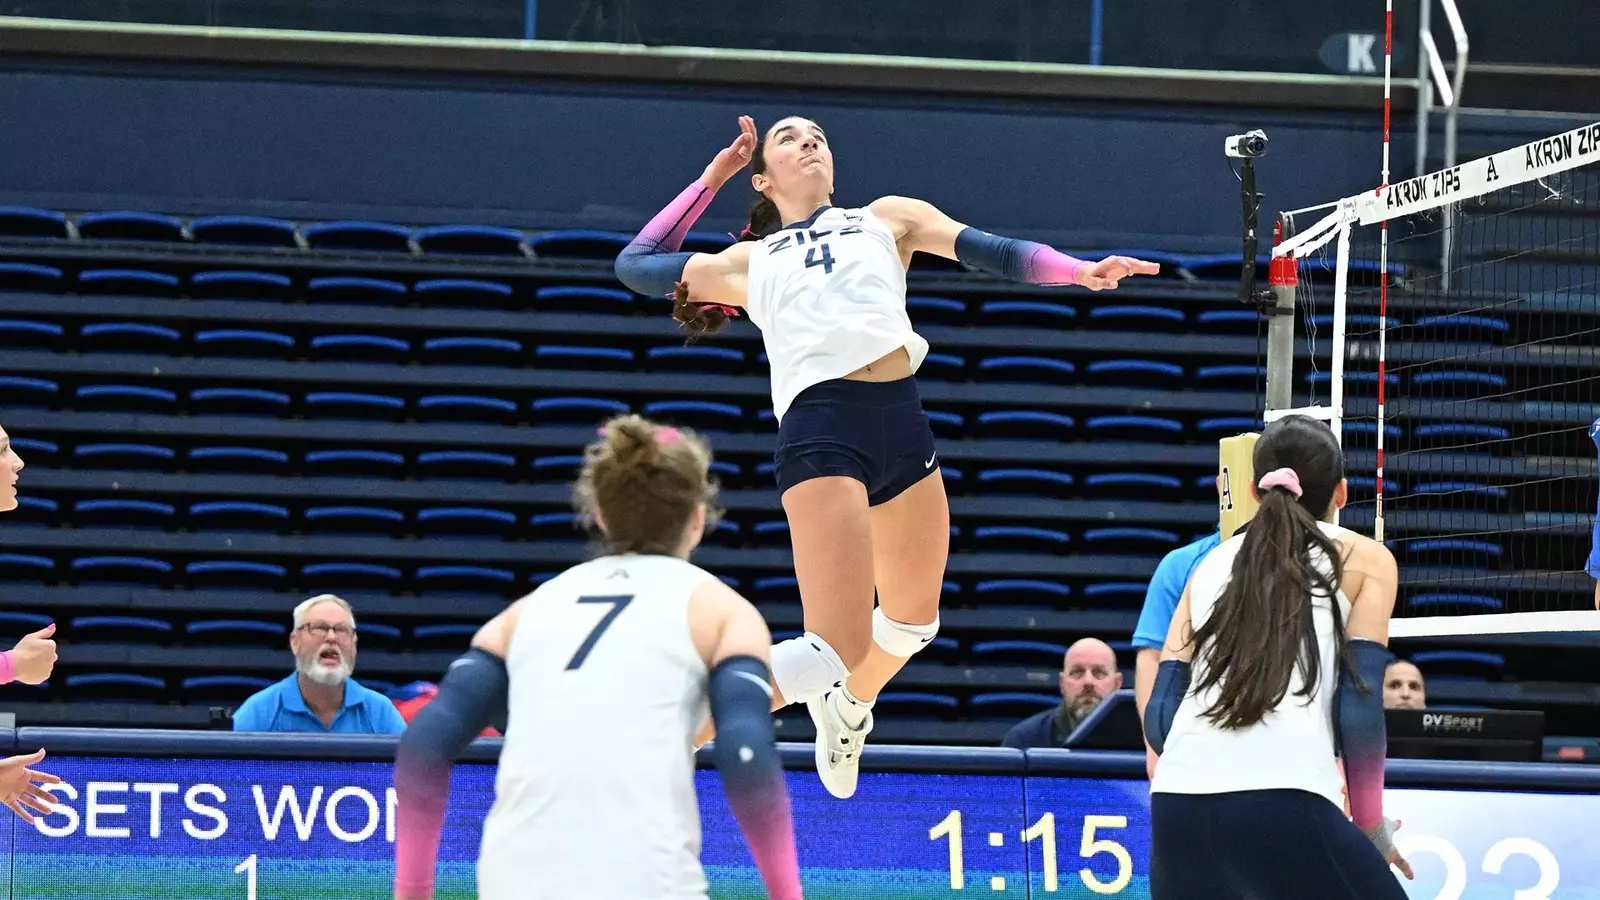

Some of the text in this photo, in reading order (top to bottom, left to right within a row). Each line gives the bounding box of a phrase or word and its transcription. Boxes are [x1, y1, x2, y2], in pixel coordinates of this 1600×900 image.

[1347, 33, 1376, 72] K
[1387, 177, 1428, 209] AKRON
[1433, 167, 1460, 198] ZIPS
[1486, 157, 1500, 182] A
[1525, 134, 1572, 171] AKRON
[805, 243, 836, 274] 4
[1221, 467, 1232, 510] A
[565, 594, 634, 671] 7
[34, 781, 229, 840] SETS
[234, 854, 258, 900] 1
[929, 810, 1133, 894] 1:15
